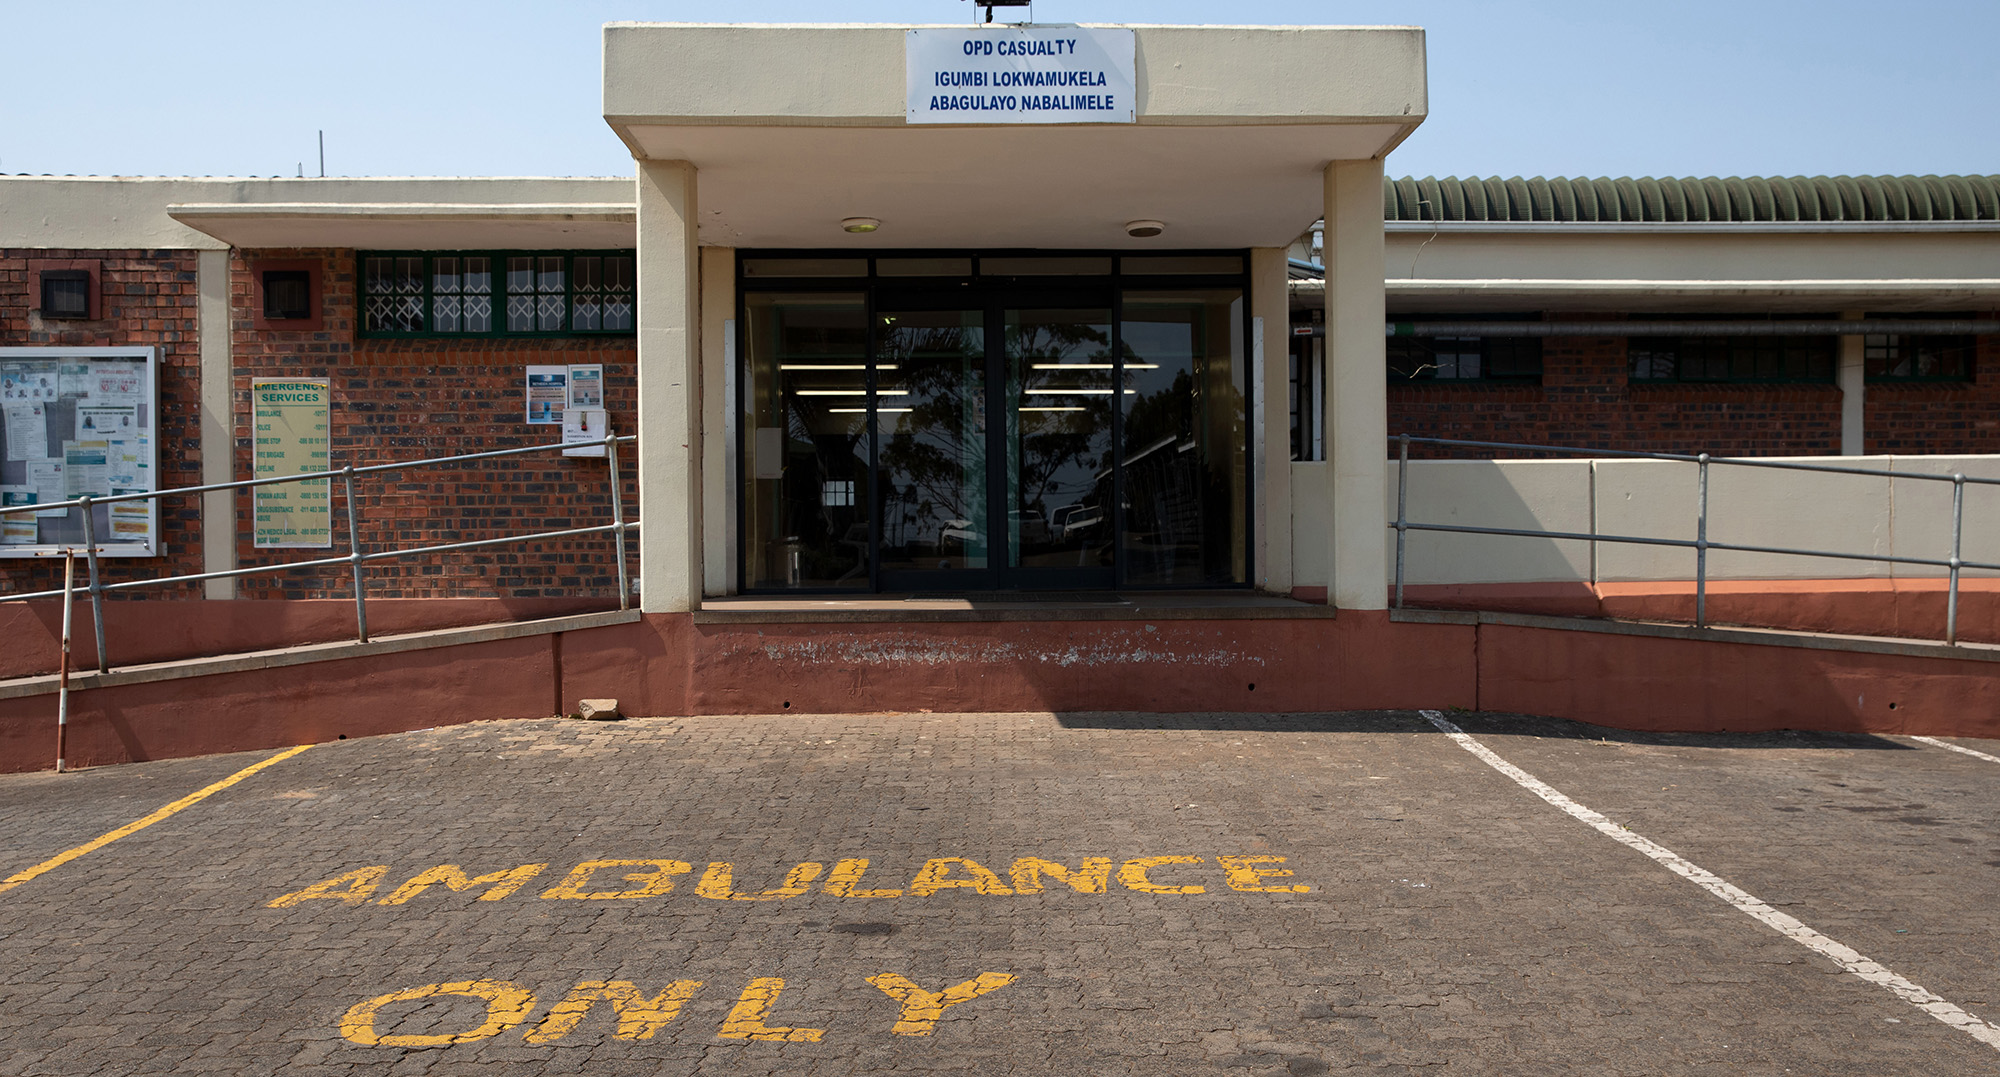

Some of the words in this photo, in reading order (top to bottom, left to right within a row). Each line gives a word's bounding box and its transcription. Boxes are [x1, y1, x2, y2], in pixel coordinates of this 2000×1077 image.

[963, 40, 993, 55] OPD
[997, 39, 1077, 55] CASUALTY
[934, 71, 988, 87] IGUMBI
[993, 71, 1107, 87] LOKWAMUKELA
[929, 95, 1017, 110] ABAGULAYO
[1022, 95, 1114, 110] NABALIMELE
[262, 394, 319, 402] SERVICES
[264, 855, 1311, 908] AMBULANCE
[338, 971, 1020, 1046] ONLY
